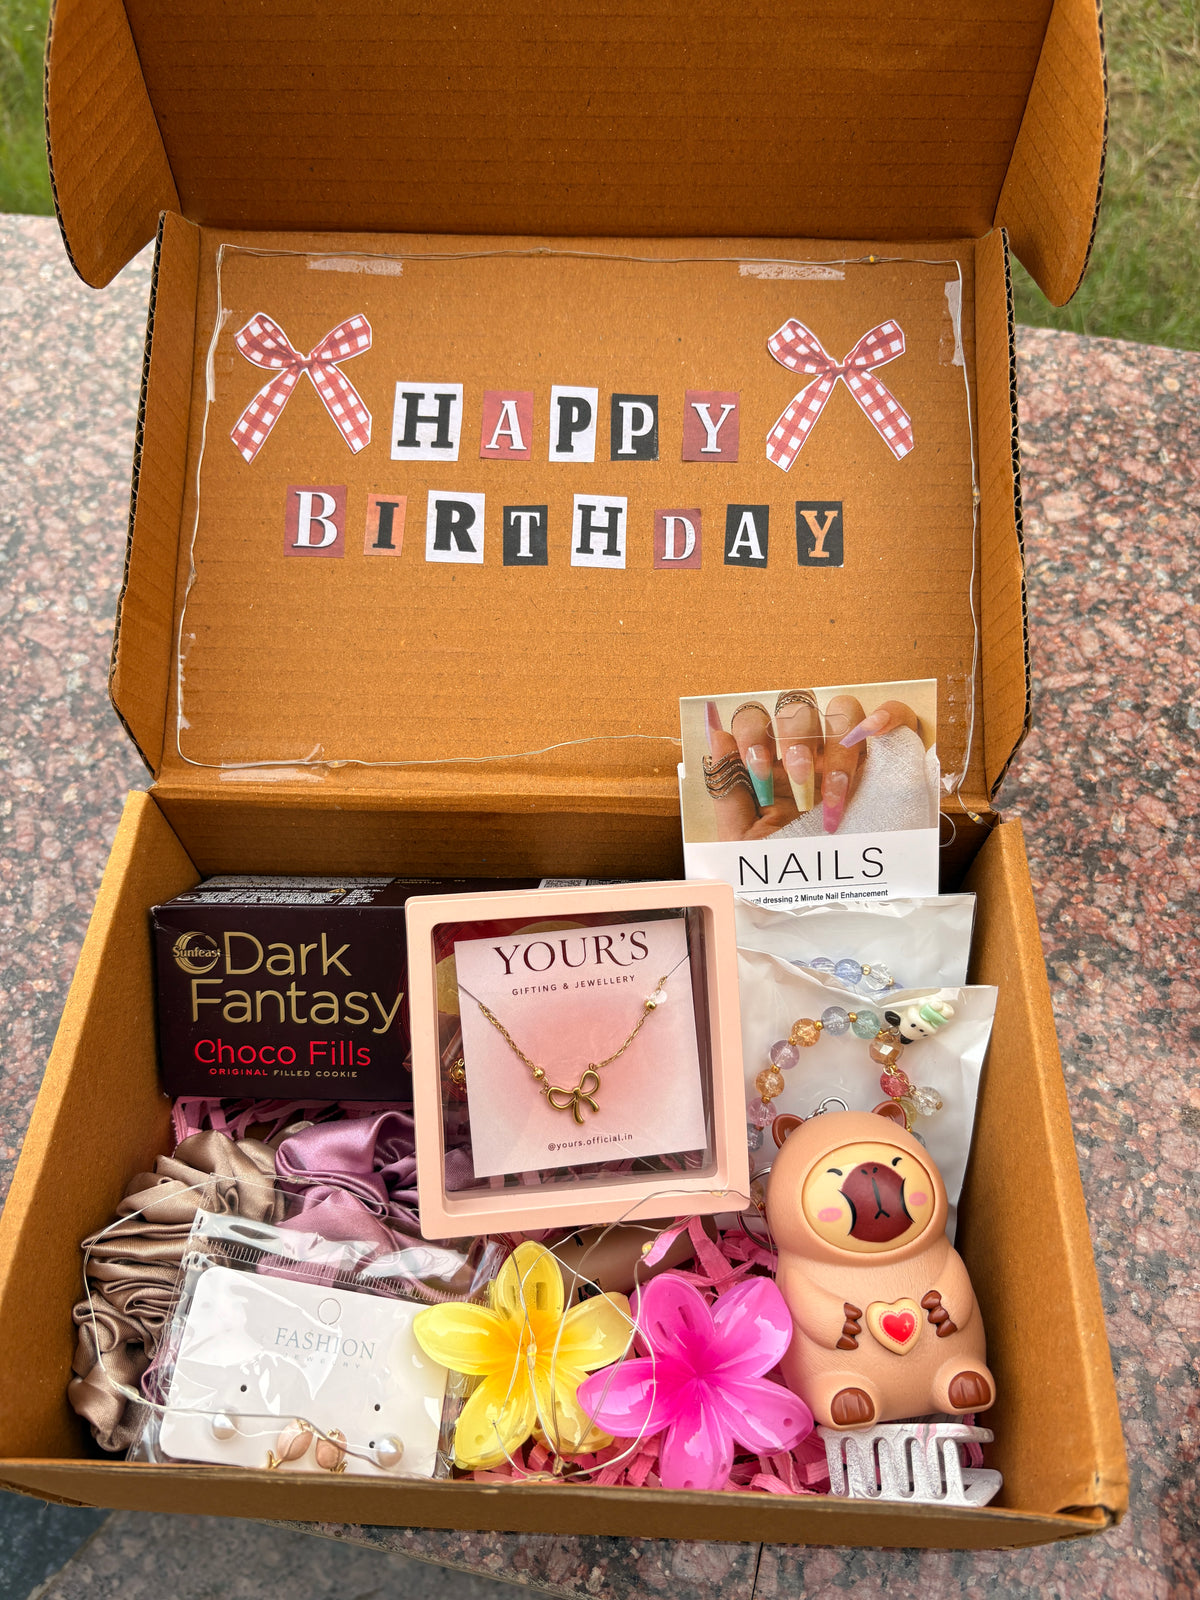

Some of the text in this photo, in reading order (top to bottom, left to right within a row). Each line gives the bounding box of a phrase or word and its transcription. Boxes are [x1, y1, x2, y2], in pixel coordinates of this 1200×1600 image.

[397, 392, 736, 453] HAPPY
[292, 490, 839, 561] BIRTHDAY
[738, 847, 884, 886] NAILS
[763, 895, 793, 905] dressing
[794, 894, 799, 902] 2
[800, 892, 824, 902] Minute
[825, 891, 839, 900] Nail
[840, 889, 889, 899] Enhancement
[172, 945, 221, 958] Sunfeast
[224, 931, 352, 977] Dark
[492, 930, 650, 976] YOUR'S
[511, 974, 636, 996] GIFTING & JEWELLERY
[191, 978, 404, 1035] Fantasy
[194, 1039, 371, 1066] Choco Fills
[209, 1067, 358, 1078] ORIGINAL FILLED COOKIE
[547, 1132, 633, 1152] @yours.official.in
[274, 1327, 376, 1360] FASHION
